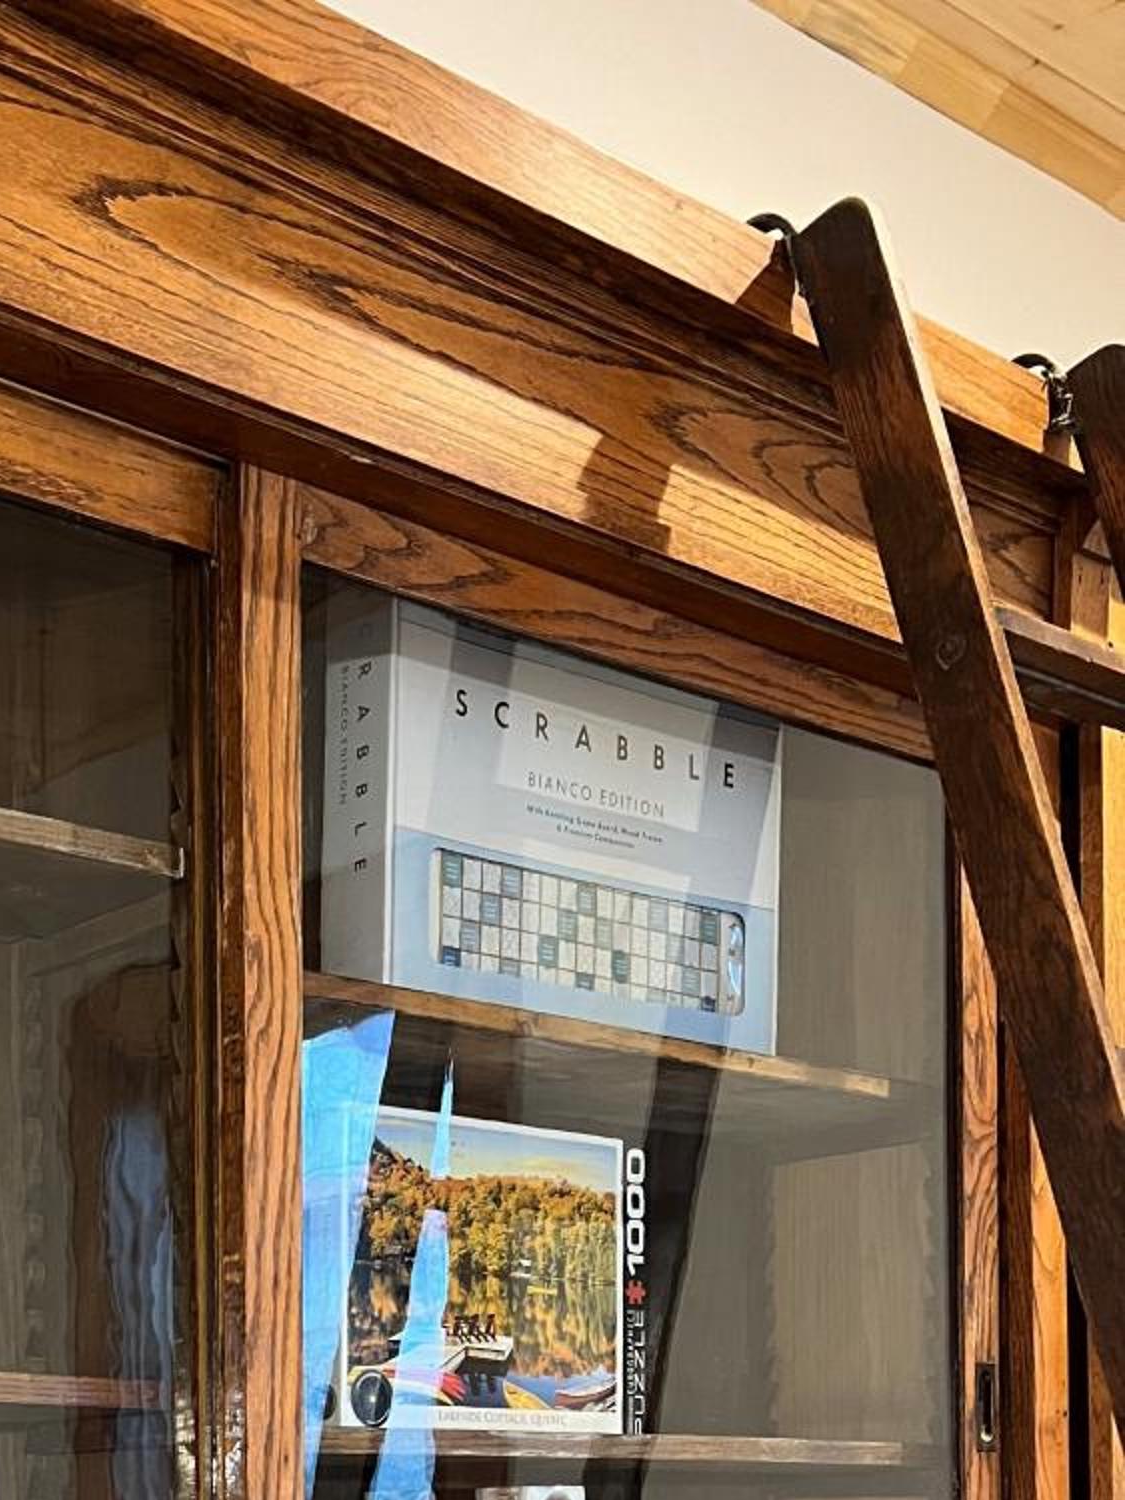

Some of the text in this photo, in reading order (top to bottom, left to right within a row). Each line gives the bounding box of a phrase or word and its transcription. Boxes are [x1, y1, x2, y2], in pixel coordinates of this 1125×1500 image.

[455, 689, 735, 789] SCRABBLE
[528, 772, 665, 818] BIANCO EDITION
[626, 1148, 646, 1435] PUZZLE 1000
